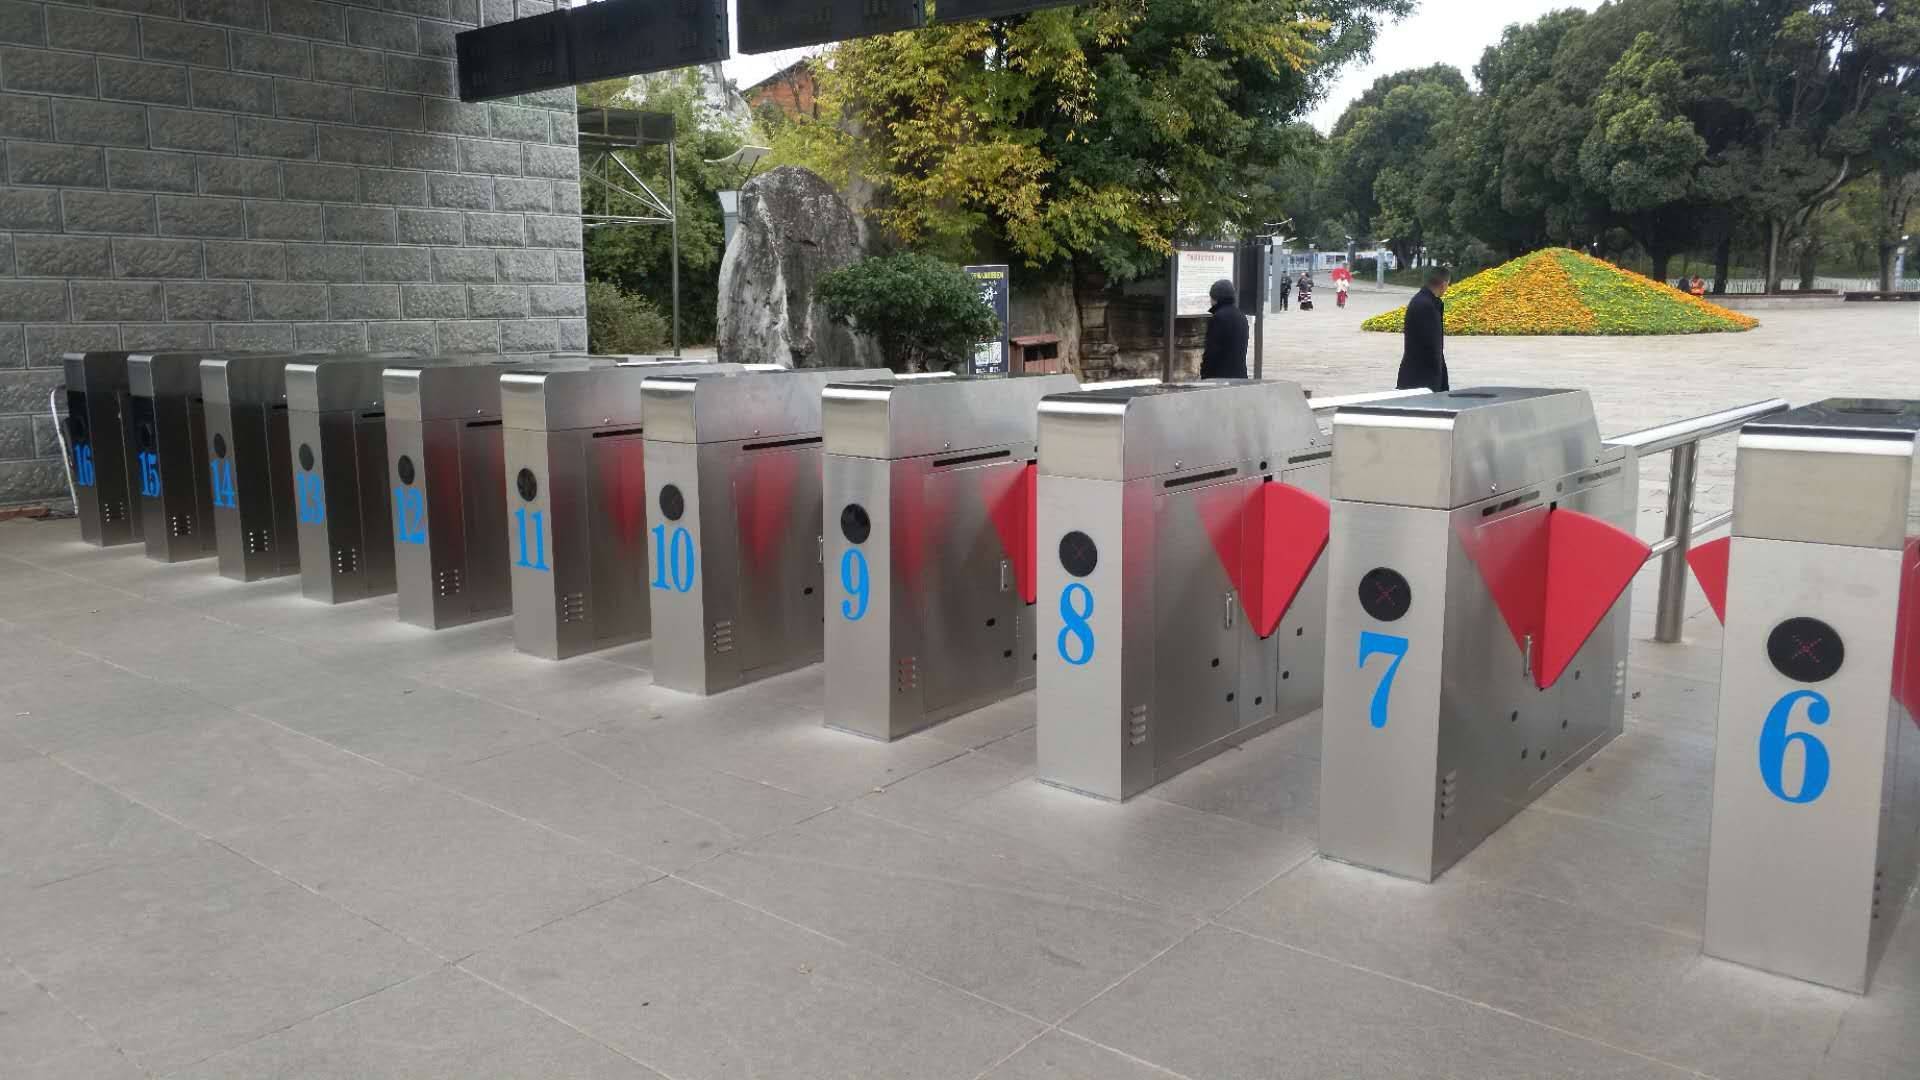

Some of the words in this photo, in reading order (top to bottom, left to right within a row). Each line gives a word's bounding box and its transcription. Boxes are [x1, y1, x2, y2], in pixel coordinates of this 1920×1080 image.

[75, 445, 94, 487] 16
[139, 452, 162, 497] 15
[210, 460, 236, 509] 14
[296, 473, 325, 525] 13
[394, 487, 427, 544] 12
[514, 508, 549, 572] 11
[651, 523, 695, 592] 10
[840, 547, 870, 621] 9
[1056, 582, 1095, 666] 8
[1358, 631, 1409, 728] 7
[1758, 689, 1830, 804] 6
